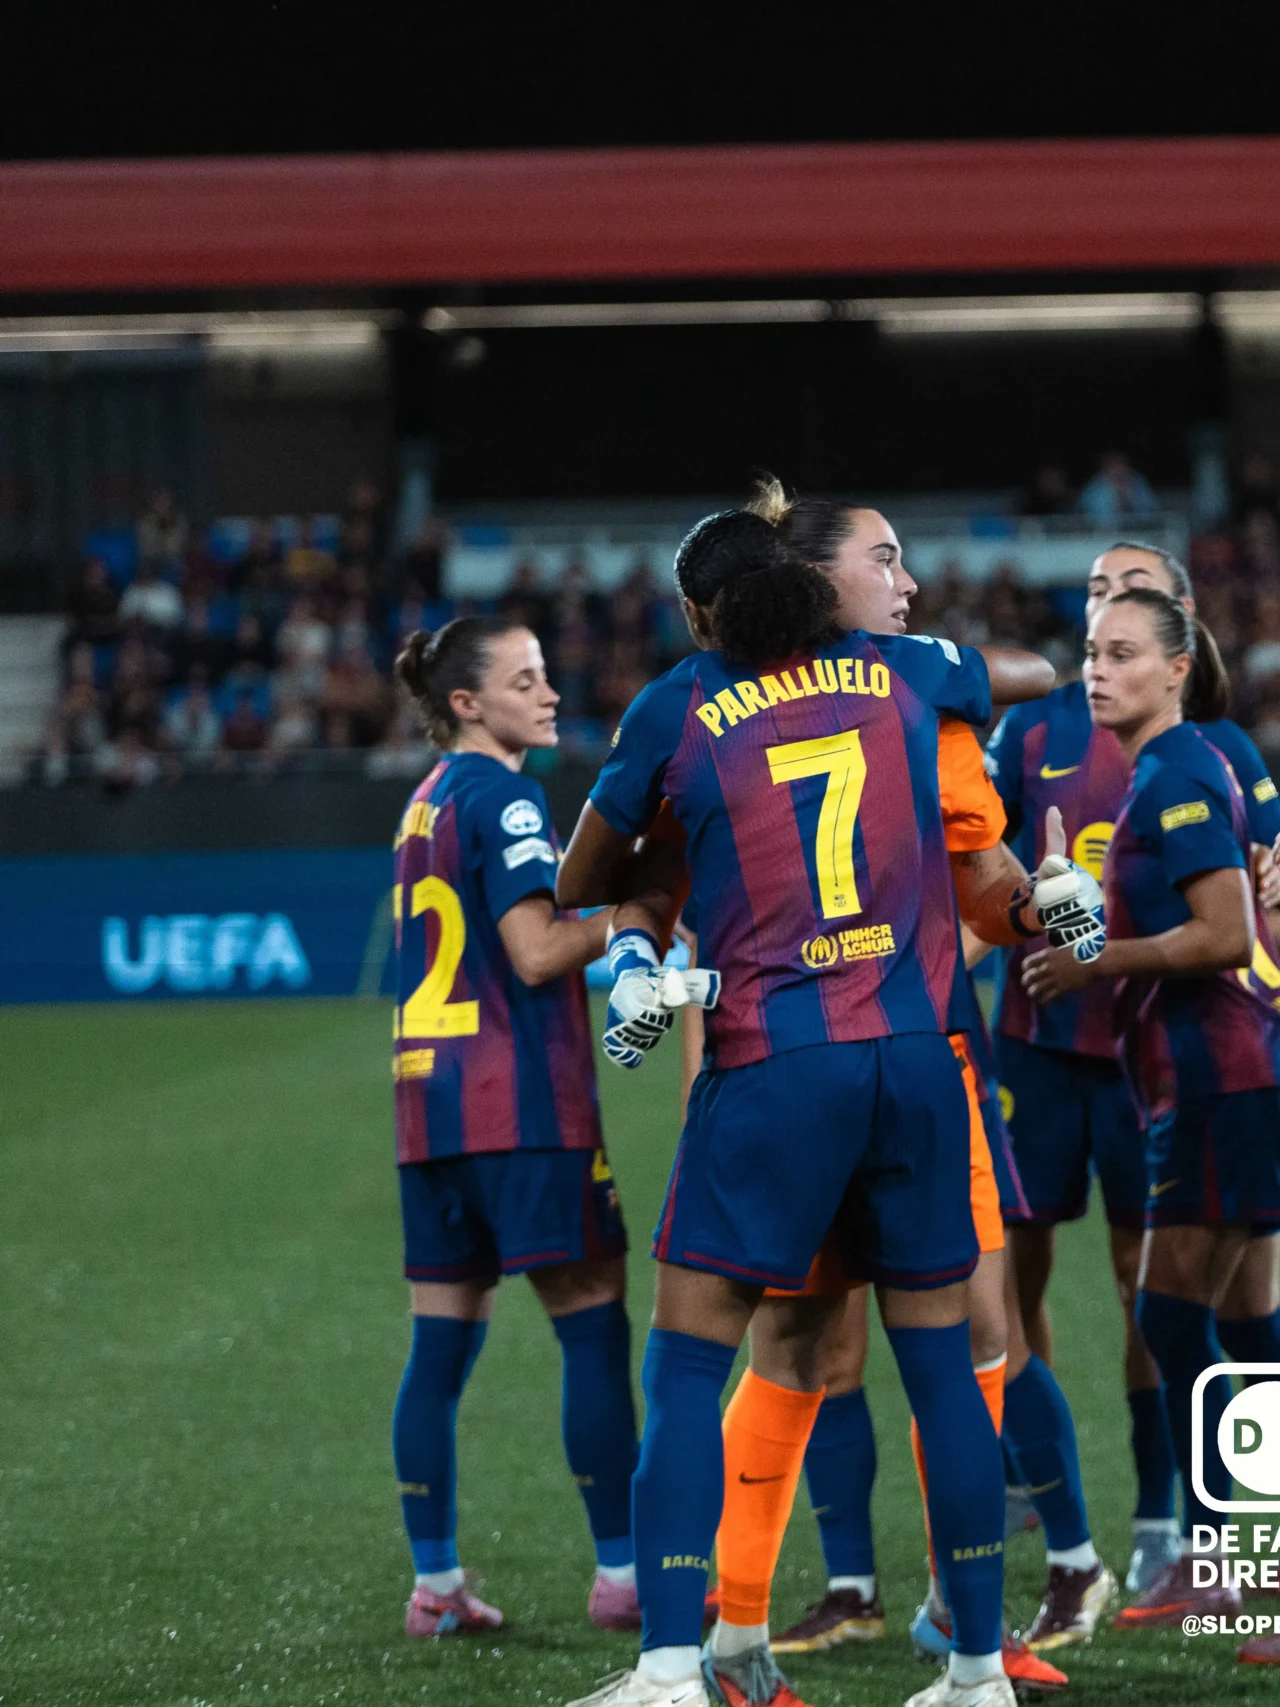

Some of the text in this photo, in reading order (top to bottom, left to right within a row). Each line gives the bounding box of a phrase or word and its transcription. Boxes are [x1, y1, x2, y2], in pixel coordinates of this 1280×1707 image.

[695, 658, 891, 737] PARALLUELO
[765, 729, 867, 919] 7
[103, 912, 312, 993] UEFA
[838, 923, 893, 945] UNHCR
[842, 936, 896, 957] ACNUR
